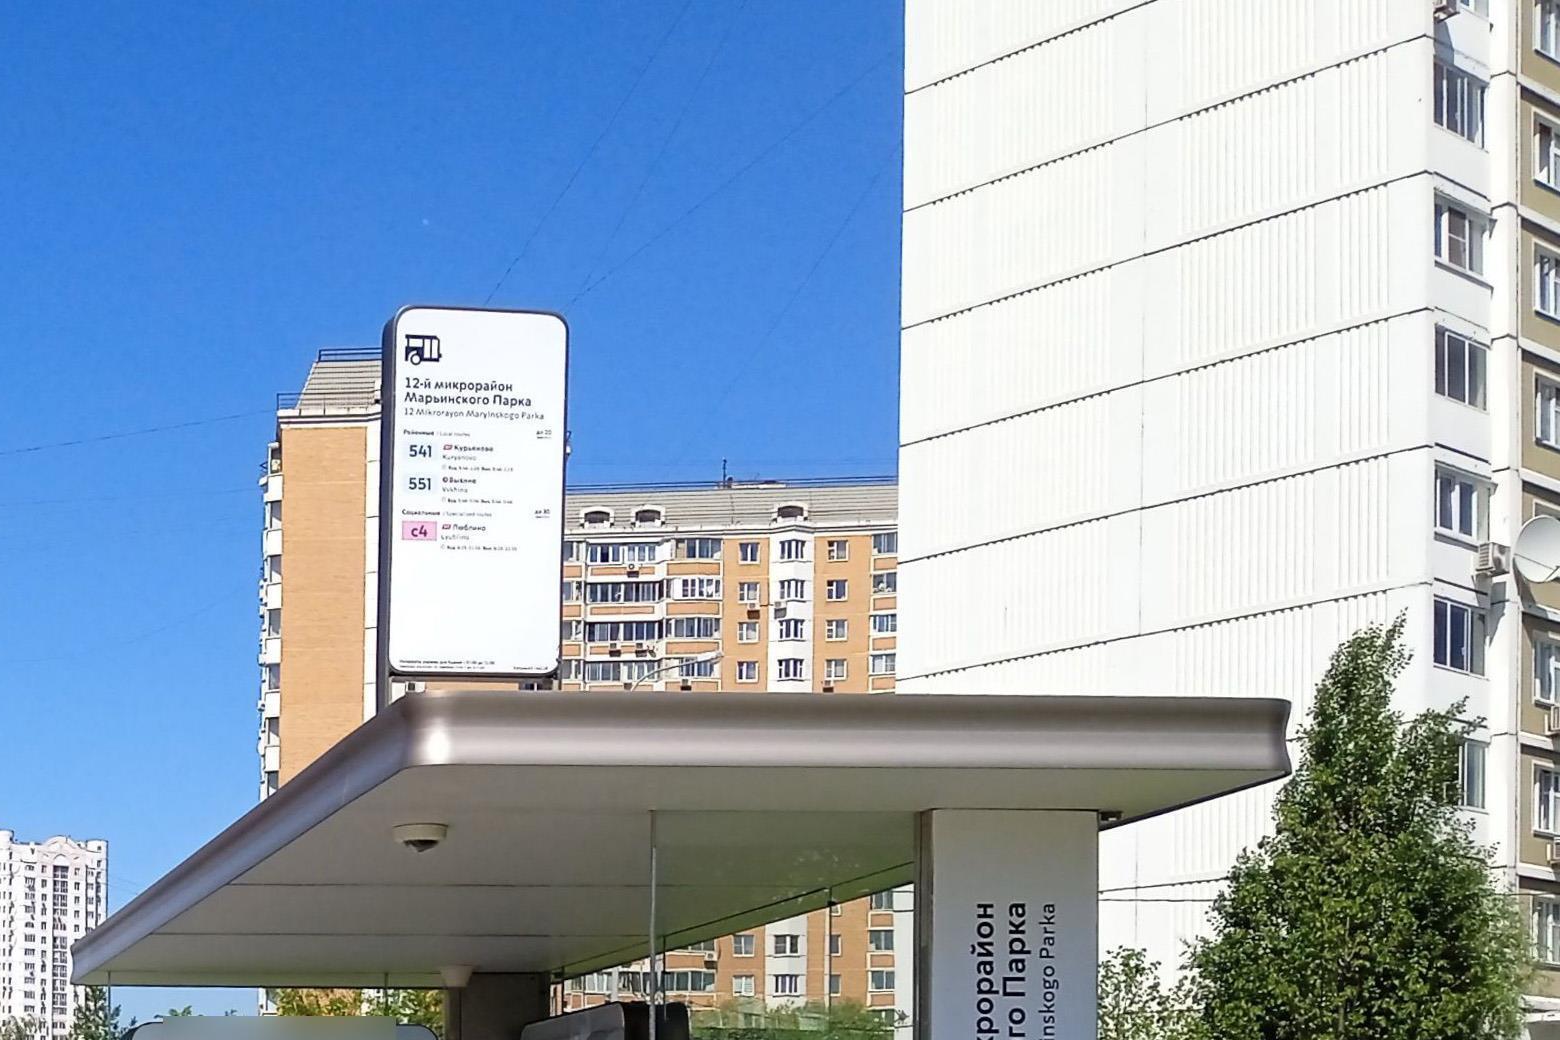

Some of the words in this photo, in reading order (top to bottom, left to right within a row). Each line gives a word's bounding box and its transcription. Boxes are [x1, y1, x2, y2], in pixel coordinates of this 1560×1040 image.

[405, 377, 431, 389] 12-й
[434, 380, 513, 393] микрорайон
[404, 391, 490, 405] Марьинского
[492, 394, 532, 408] Парка
[404, 407, 414, 416] 12
[415, 408, 464, 418] Mikrorayon
[466, 410, 520, 420] Maryinskogo
[521, 412, 545, 420] Parka
[409, 444, 432, 458] 541
[408, 477, 432, 491] 551
[1039, 903, 1056, 959] Parka
[1002, 902, 1032, 997] Парка
